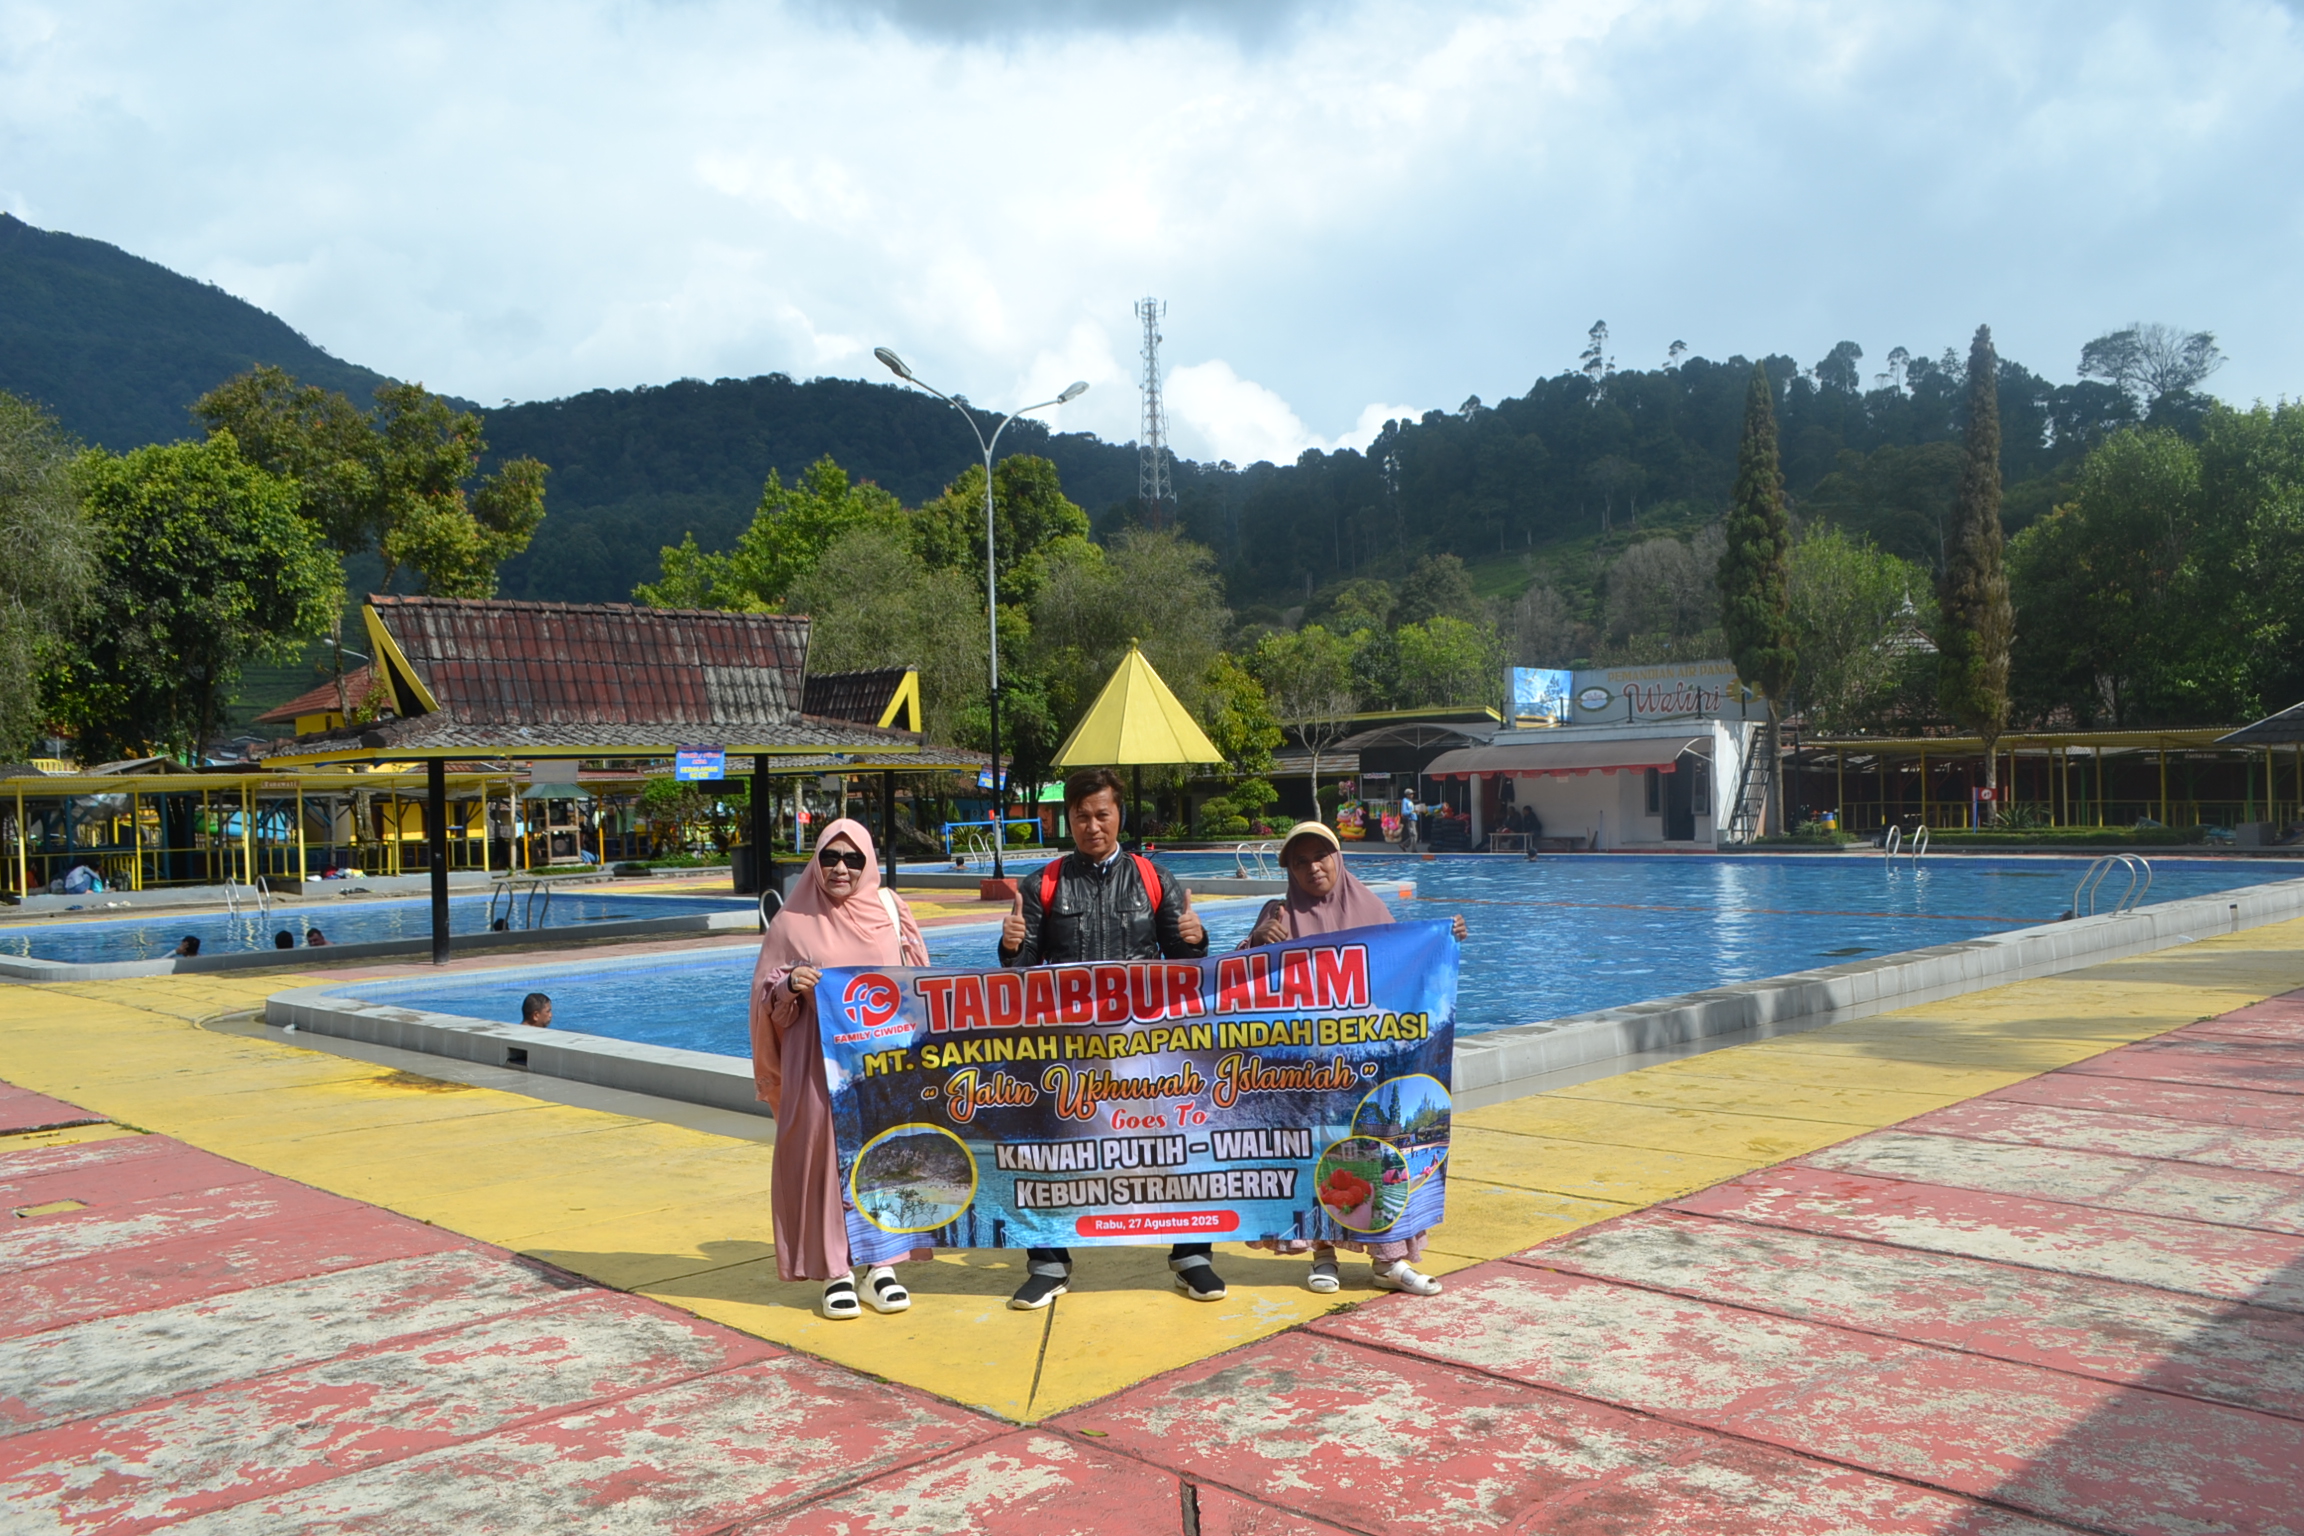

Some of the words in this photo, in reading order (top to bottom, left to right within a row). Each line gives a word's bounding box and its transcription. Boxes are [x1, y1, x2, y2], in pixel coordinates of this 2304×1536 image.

[1608, 669, 1674, 682] PEMANDIAN
[1679, 667, 1696, 677] AIR
[1700, 664, 1737, 675] PANAS
[1623, 681, 1721, 714] Walini
[917, 963, 1206, 1034] TADABBUR
[1215, 945, 1369, 1014] ALAM
[834, 1031, 870, 1044] FAMILY
[873, 1023, 917, 1038] CIWIDEY
[863, 1049, 915, 1078] MT.
[921, 1035, 1058, 1069] SAKINAH
[1064, 1024, 1212, 1059] HARAPAN
[1218, 1019, 1312, 1049] INDAH
[1318, 1012, 1429, 1045] BEKASI
[945, 1067, 1038, 1123] Jalin
[1042, 1060, 1205, 1121] Ukhuwah
[1212, 1053, 1356, 1107] Islamiah
[1111, 1108, 1167, 1130] Goes
[1174, 1101, 1208, 1127] To
[995, 1140, 1097, 1172] KAWAH
[1099, 1135, 1187, 1169] PUTIH
[1211, 1129, 1312, 1161] WALINI
[1015, 1178, 1107, 1208] KEBUN
[1109, 1168, 1298, 1204] STRAWBERRY
[1095, 1219, 1126, 1231] Rabu,
[1128, 1218, 1142, 1229] 27
[1144, 1217, 1189, 1230] Agustus
[1191, 1215, 1219, 1226] 2025
